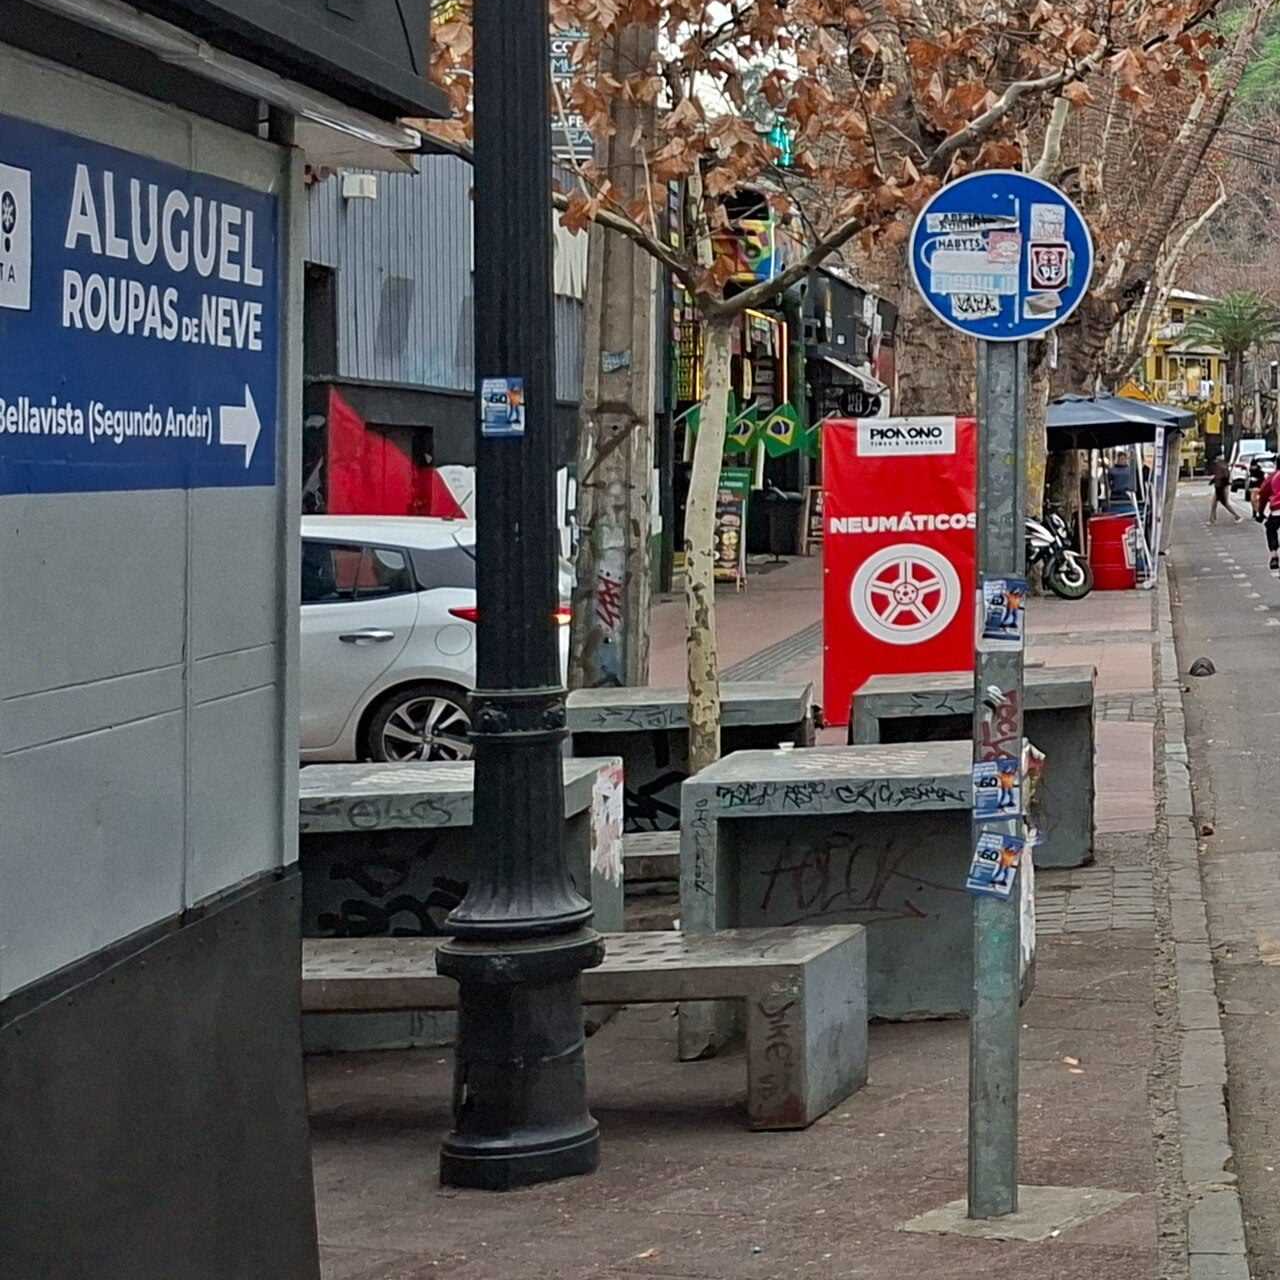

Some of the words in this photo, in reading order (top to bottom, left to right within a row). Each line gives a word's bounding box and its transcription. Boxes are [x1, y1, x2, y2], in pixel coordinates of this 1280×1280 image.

[65, 163, 263, 287] ALUGUEL
[62, 269, 179, 341] ROUPAS
[181, 317, 199, 343] DE
[201, 293, 263, 351] NEVE
[88, 400, 162, 444] (Segundo
[830, 511, 976, 534] NEUMÁTICOS
